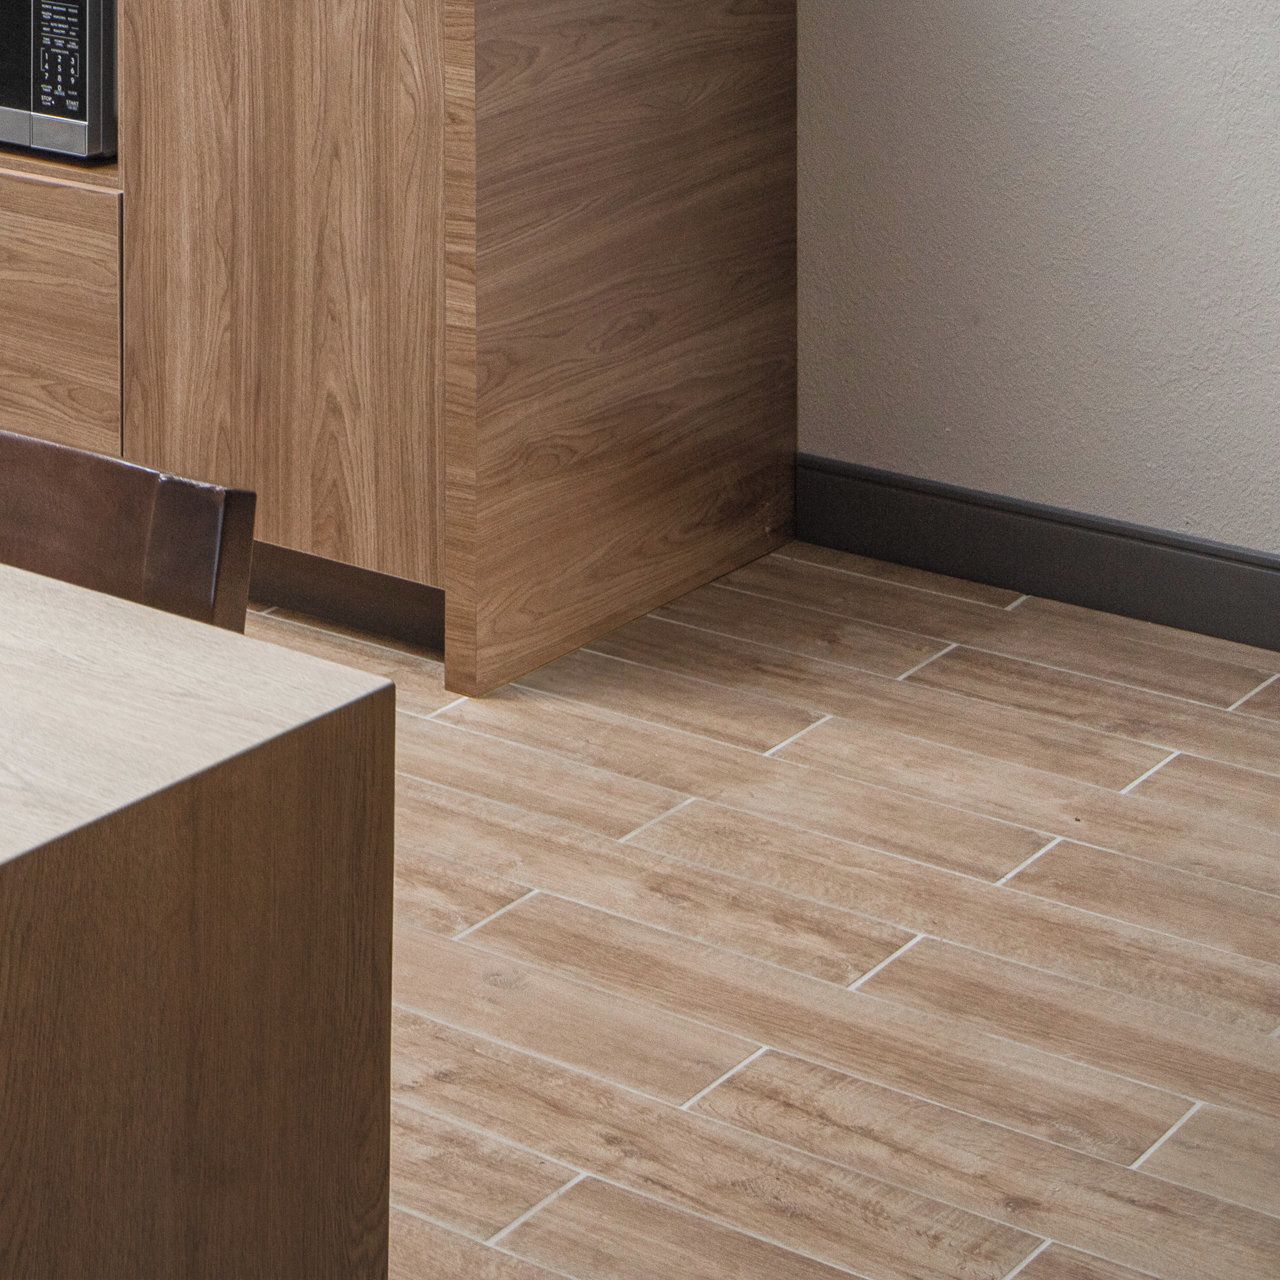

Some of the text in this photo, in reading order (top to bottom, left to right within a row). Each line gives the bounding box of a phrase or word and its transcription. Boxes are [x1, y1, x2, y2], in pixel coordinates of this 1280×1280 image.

[45, 52, 49, 60] 1
[57, 54, 62, 62] 2
[70, 57, 75, 65] 3
[57, 64, 62, 72] 5
[70, 67, 75, 75] 6
[44, 72, 49, 80] 7
[57, 74, 62, 82] 8
[70, 77, 75, 85] 9
